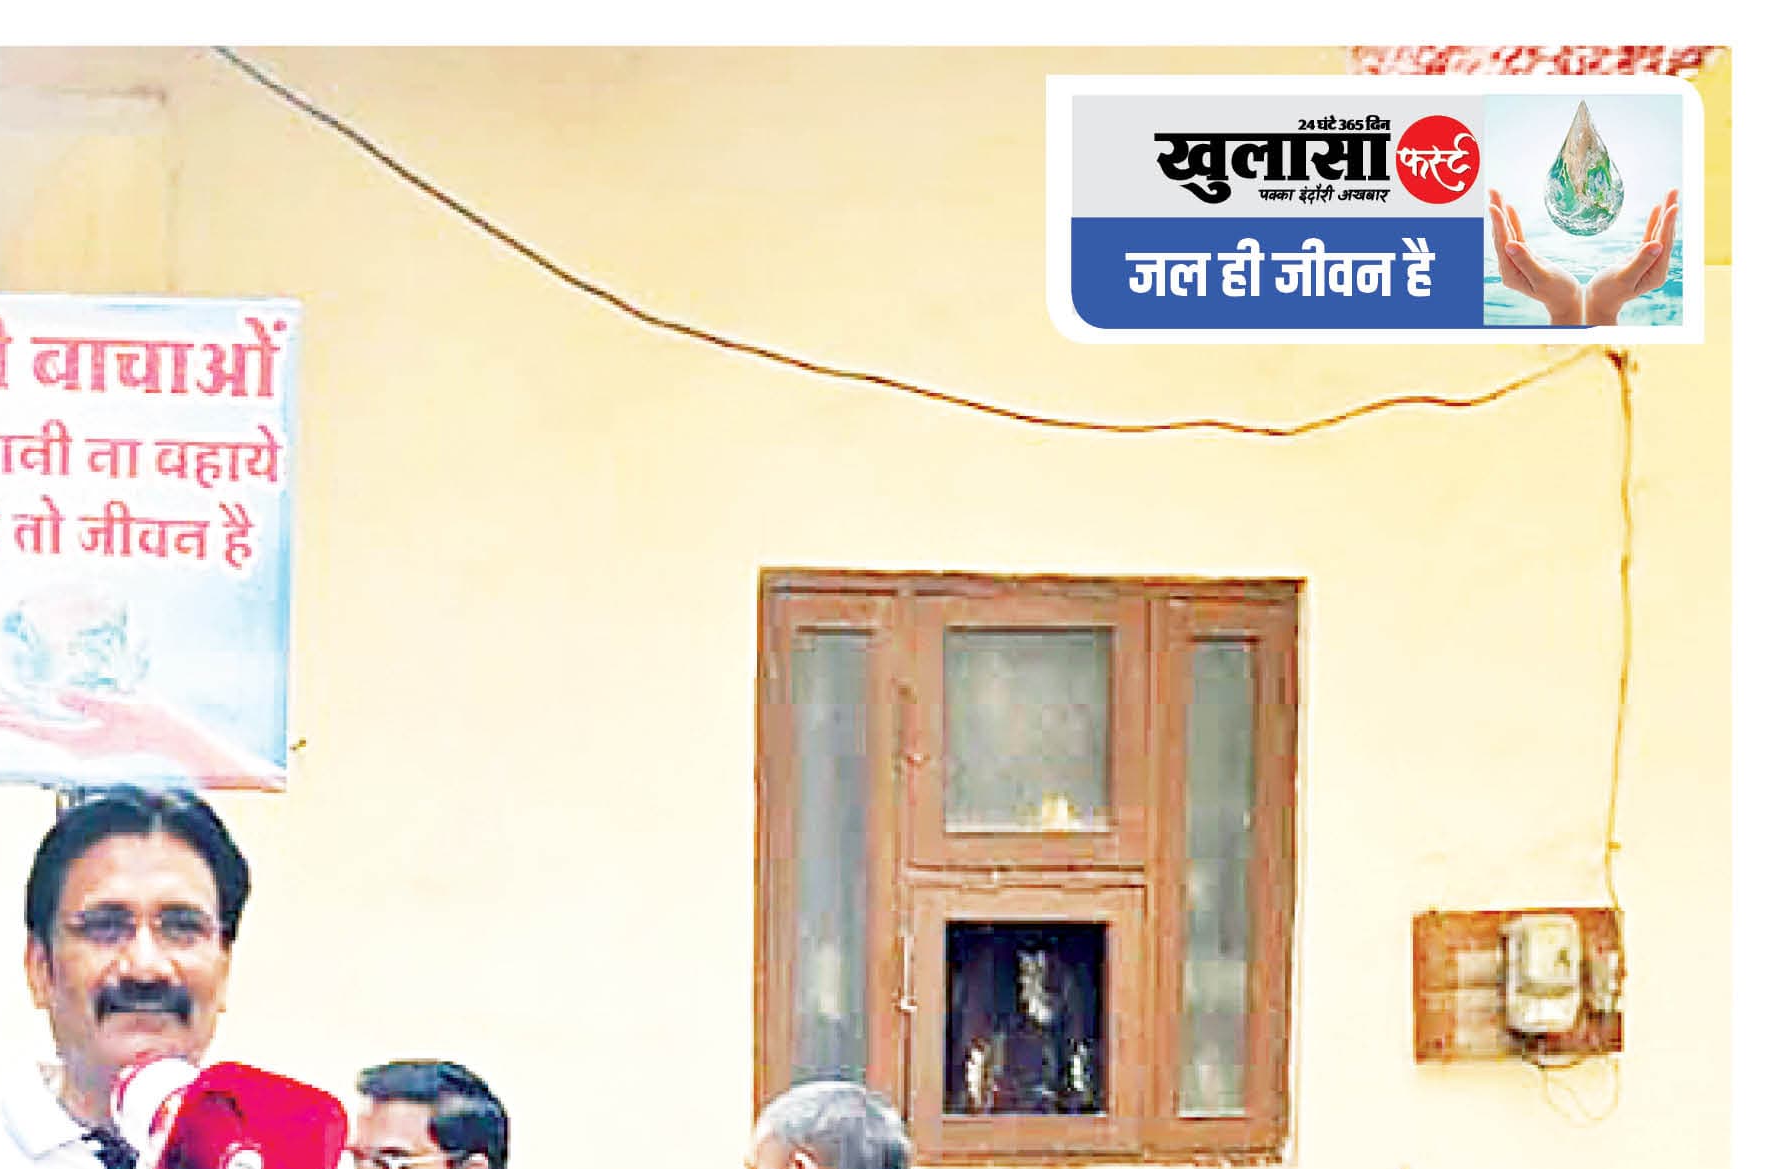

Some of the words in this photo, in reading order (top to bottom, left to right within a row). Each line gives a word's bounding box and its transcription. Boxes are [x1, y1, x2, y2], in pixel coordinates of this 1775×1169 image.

[30, 316, 289, 398] बाचाओं
[84, 438, 144, 480] ना
[11, 495, 67, 555] तो
[78, 499, 211, 561] जीवन
[219, 503, 256, 570] है
